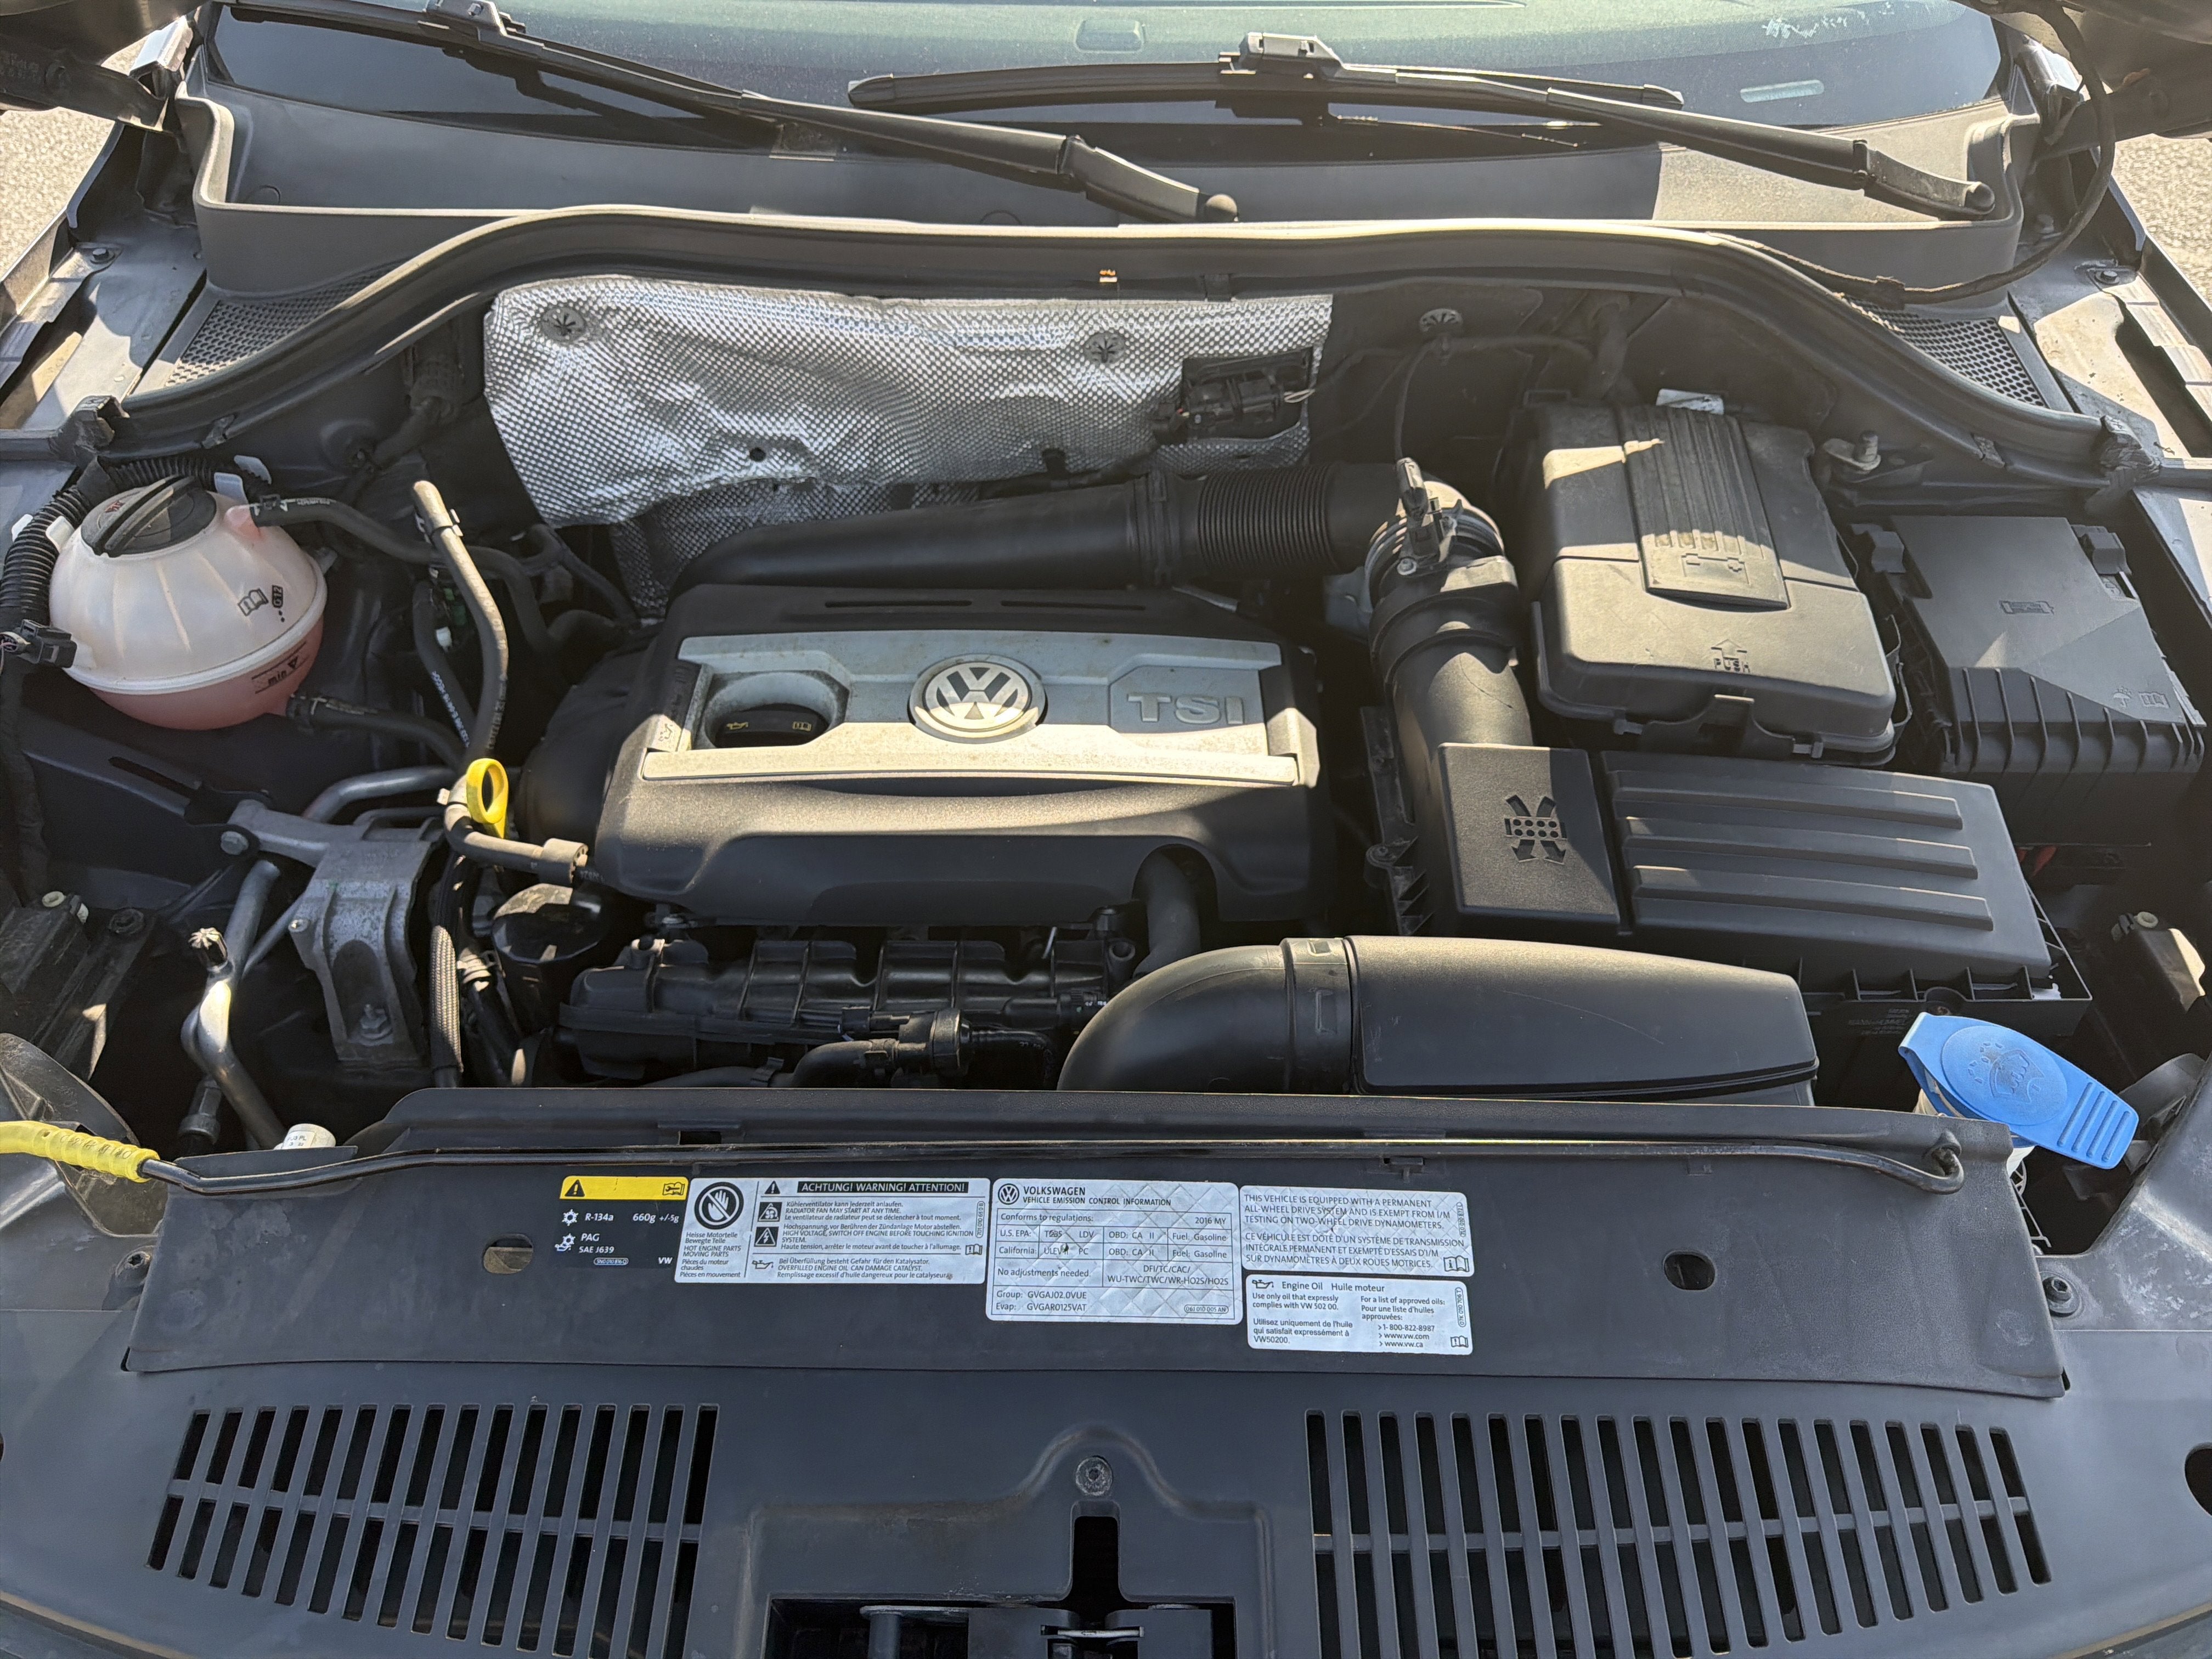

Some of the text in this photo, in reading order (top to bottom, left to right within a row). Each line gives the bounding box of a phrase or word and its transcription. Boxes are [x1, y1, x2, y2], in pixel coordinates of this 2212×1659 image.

[1713, 658, 1751, 673] PUSH
[1127, 692, 1245, 725] TSI
[802, 1182, 964, 1191] ACHTUNG! WARNING! ATTENTION!
[1023, 1186, 1085, 1195] VOLKSWAGEN
[1123, 1198, 1171, 1206] INFORMATION
[1244, 1194, 1262, 1204] THIS
[1263, 1194, 1297, 1204] VEHICLE
[1308, 1196, 1349, 1205] EQUIPPED
[1382, 1198, 1431, 1207] PERMANENT
[585, 1212, 613, 1221] R-134a
[1244, 1205, 1289, 1215] ALL-WHEEL
[1291, 1206, 1316, 1216] DRIVE
[1317, 1207, 1347, 1217] SYSTEM
[1348, 1207, 1367, 1217] AND
[1379, 1209, 1409, 1217] EXEMPT
[1412, 1210, 1435, 1219] FROM
[1436, 1210, 1450, 1218] I/M
[633, 1213, 656, 1223] 660g
[1001, 1212, 1093, 1223] Conforms to regulations:
[1195, 1217, 1212, 1225] 2016
[1244, 1215, 1278, 1223] TESTING
[1295, 1217, 1346, 1227] TWO-WHEEL
[1348, 1218, 1372, 1226] DRIVE
[1374, 1218, 1443, 1229] DYNAMOMETERS.
[580, 1233, 600, 1241] PAG
[1079, 1231, 1094, 1239] LDV
[1132, 1232, 1143, 1240] CA
[1193, 1232, 1226, 1242] Gasoline
[1256, 1232, 1295, 1242] VÉHICULE
[1335, 1233, 1356, 1243] D'UN
[1405, 1238, 1465, 1247] TRANSMISSION
[998, 1246, 1039, 1255] California:
[1108, 1248, 1128, 1257] OBD:
[1194, 1250, 1227, 1258] Gasoline
[1246, 1243, 1289, 1252] INTÉGRALE
[1289, 1245, 1336, 1254] PERMANENT
[1348, 1245, 1383, 1255] EXEMPTÉ
[1384, 1248, 1417, 1256] D'ESSAIS
[1339, 1256, 1361, 1267] DEUX
[1363, 1257, 1390, 1267] ROUES
[1391, 1257, 1432, 1268] MOTRICES.
[1010, 1268, 1058, 1279] adjustments
[1143, 1264, 1190, 1275] DFI/TC/CAC/
[1282, 1281, 1310, 1291] Engine
[1311, 1282, 1323, 1290] Oil
[1331, 1283, 1352, 1291] Huile
[996, 1290, 1023, 1300] Group:
[1266, 1293, 1280, 1302] only
[1291, 1293, 1306, 1302] that
[1307, 1294, 1339, 1303] expressly
[1026, 1302, 1087, 1311] GVGAR0125VAT
[1252, 1301, 1282, 1310] complies
[1314, 1301, 1326, 1310] 502
[1398, 1297, 1430, 1306] approved
[996, 1302, 1016, 1312] Evap:
[1362, 1313, 1402, 1321] approuvées:
[1253, 1318, 1278, 1328] Utilisez
[1280, 1318, 1321, 1329] uniquement
[1253, 1327, 1264, 1336] qui
[1266, 1327, 1293, 1337] satisfait
[1294, 1328, 1343, 1338] expressément
